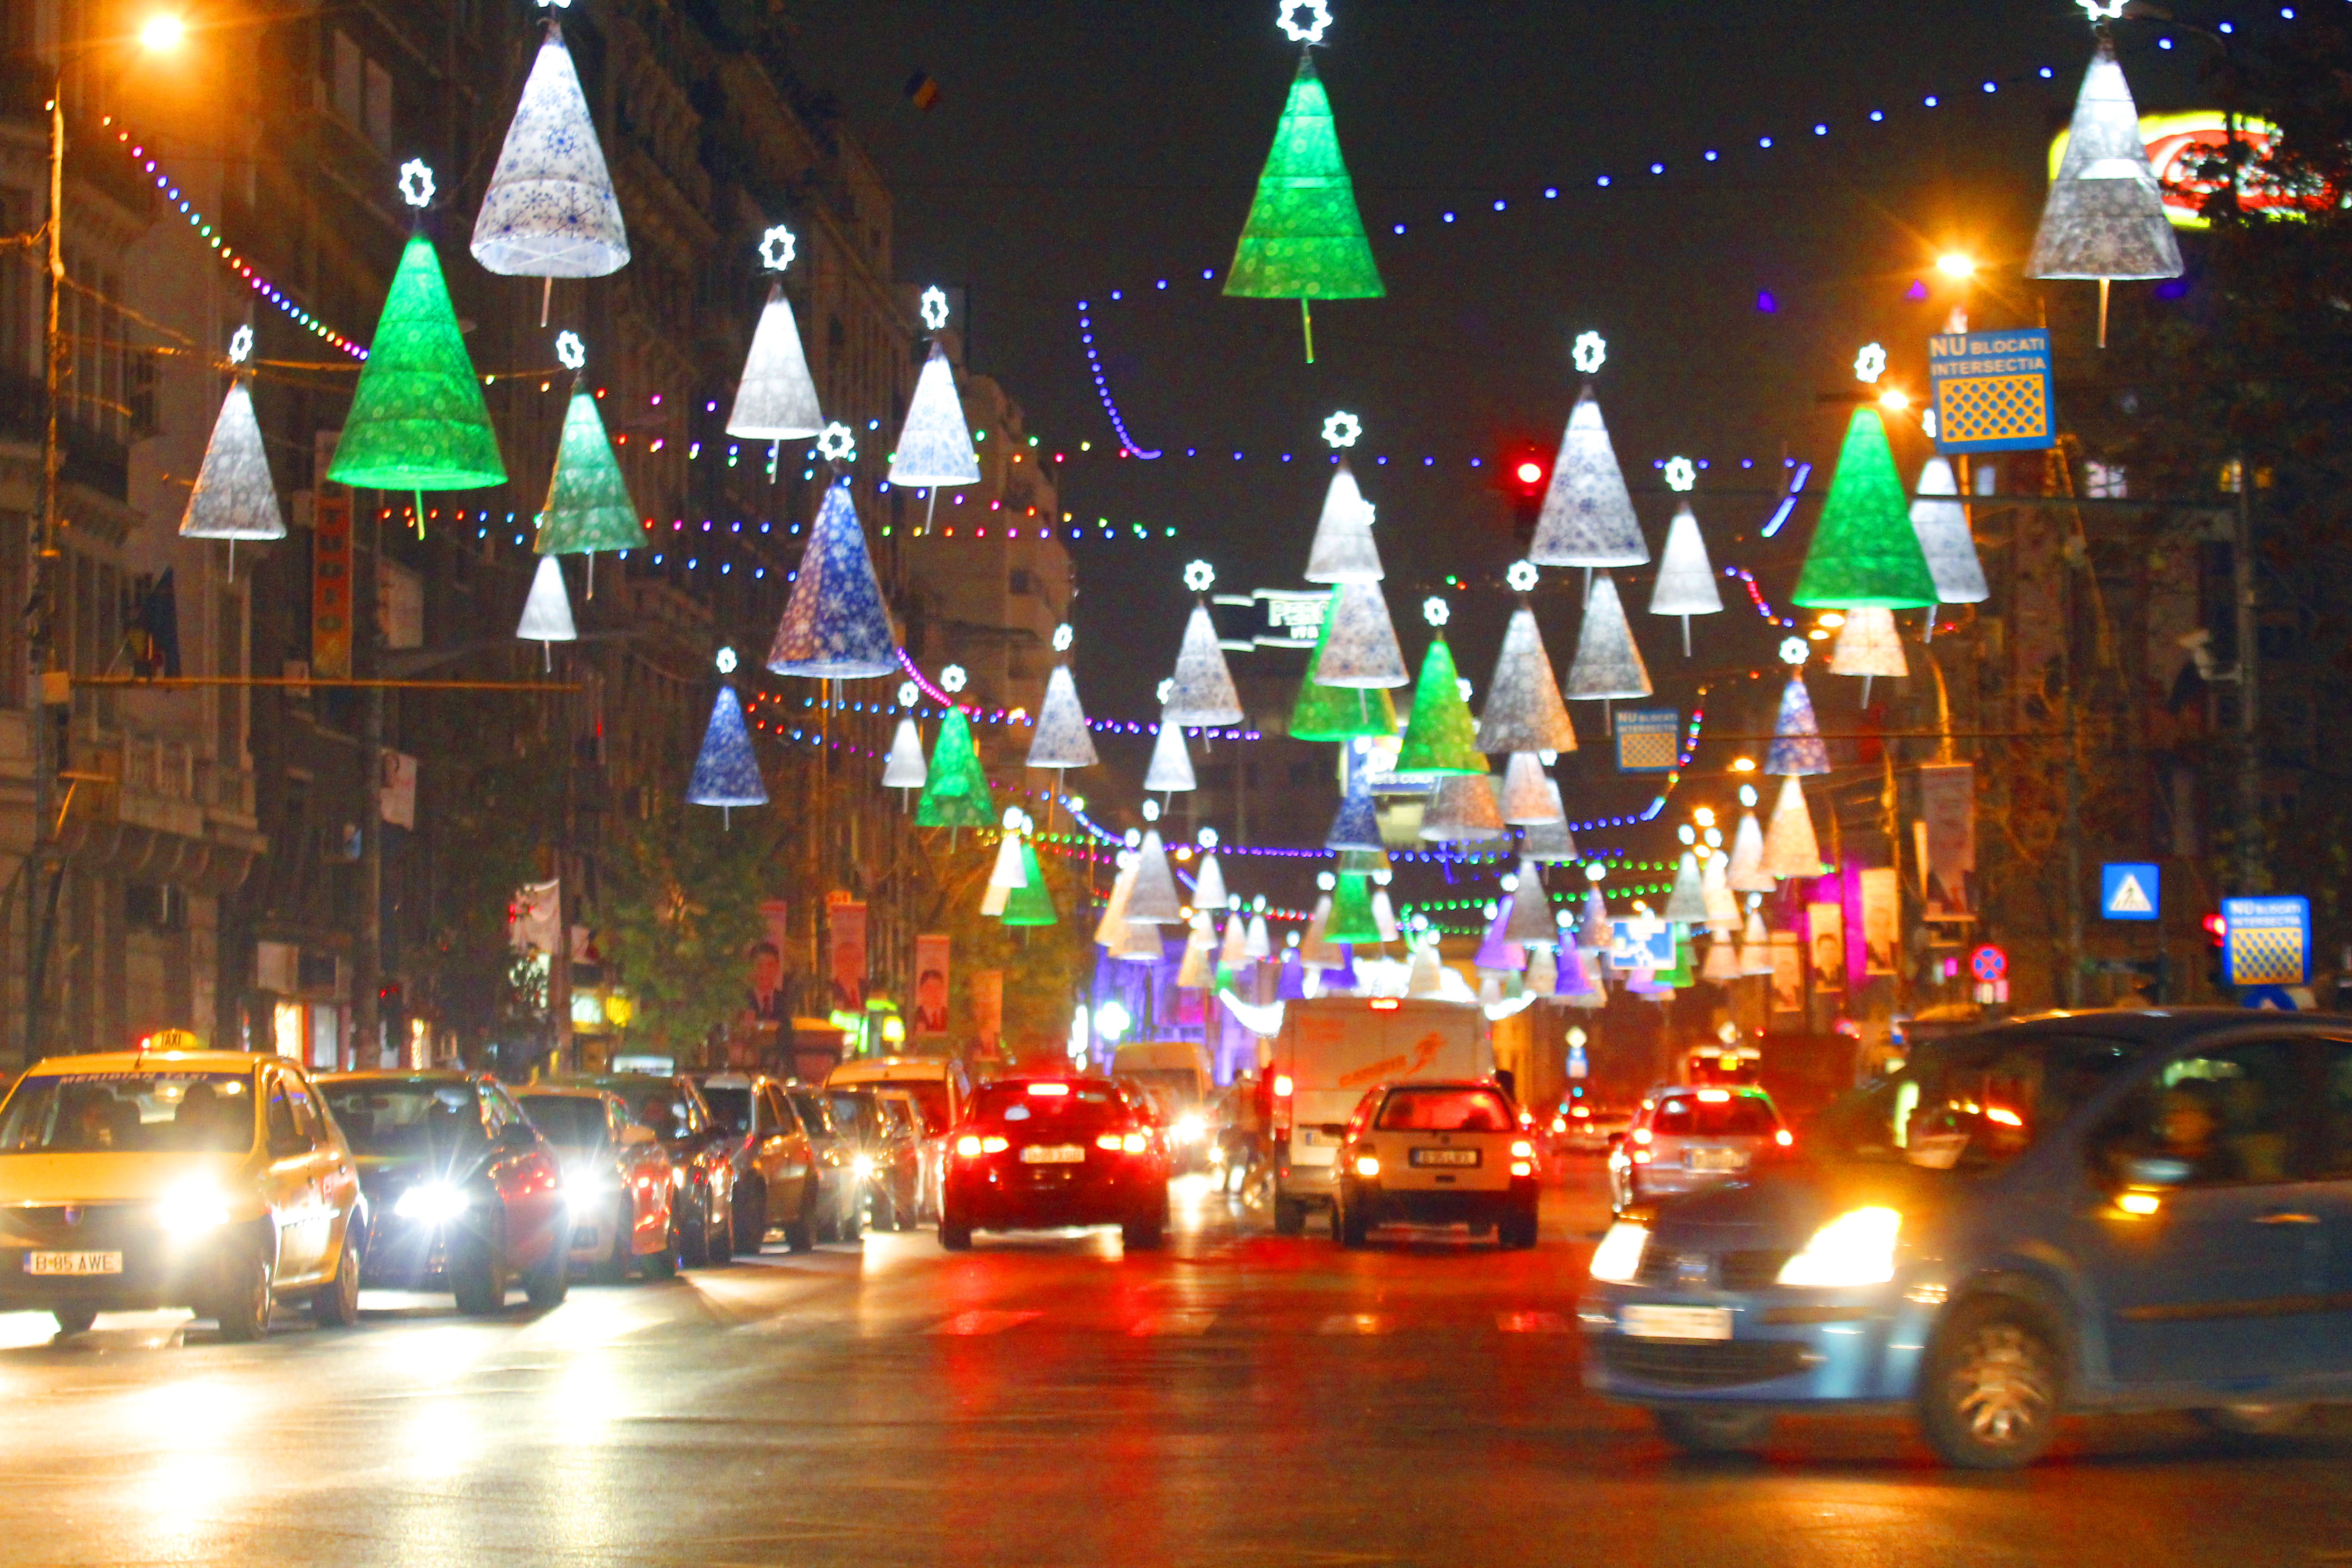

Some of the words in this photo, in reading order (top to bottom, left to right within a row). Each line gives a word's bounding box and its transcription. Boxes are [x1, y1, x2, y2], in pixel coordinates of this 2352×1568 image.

[1931, 337, 1967, 357] NU
[1971, 338, 2045, 355] BLOCATI
[1931, 358, 2046, 376] INTERSECTIA
[2231, 901, 2254, 915] NU
[161, 1033, 181, 1047] TAXI
[78, 1254, 114, 1271] AWE
